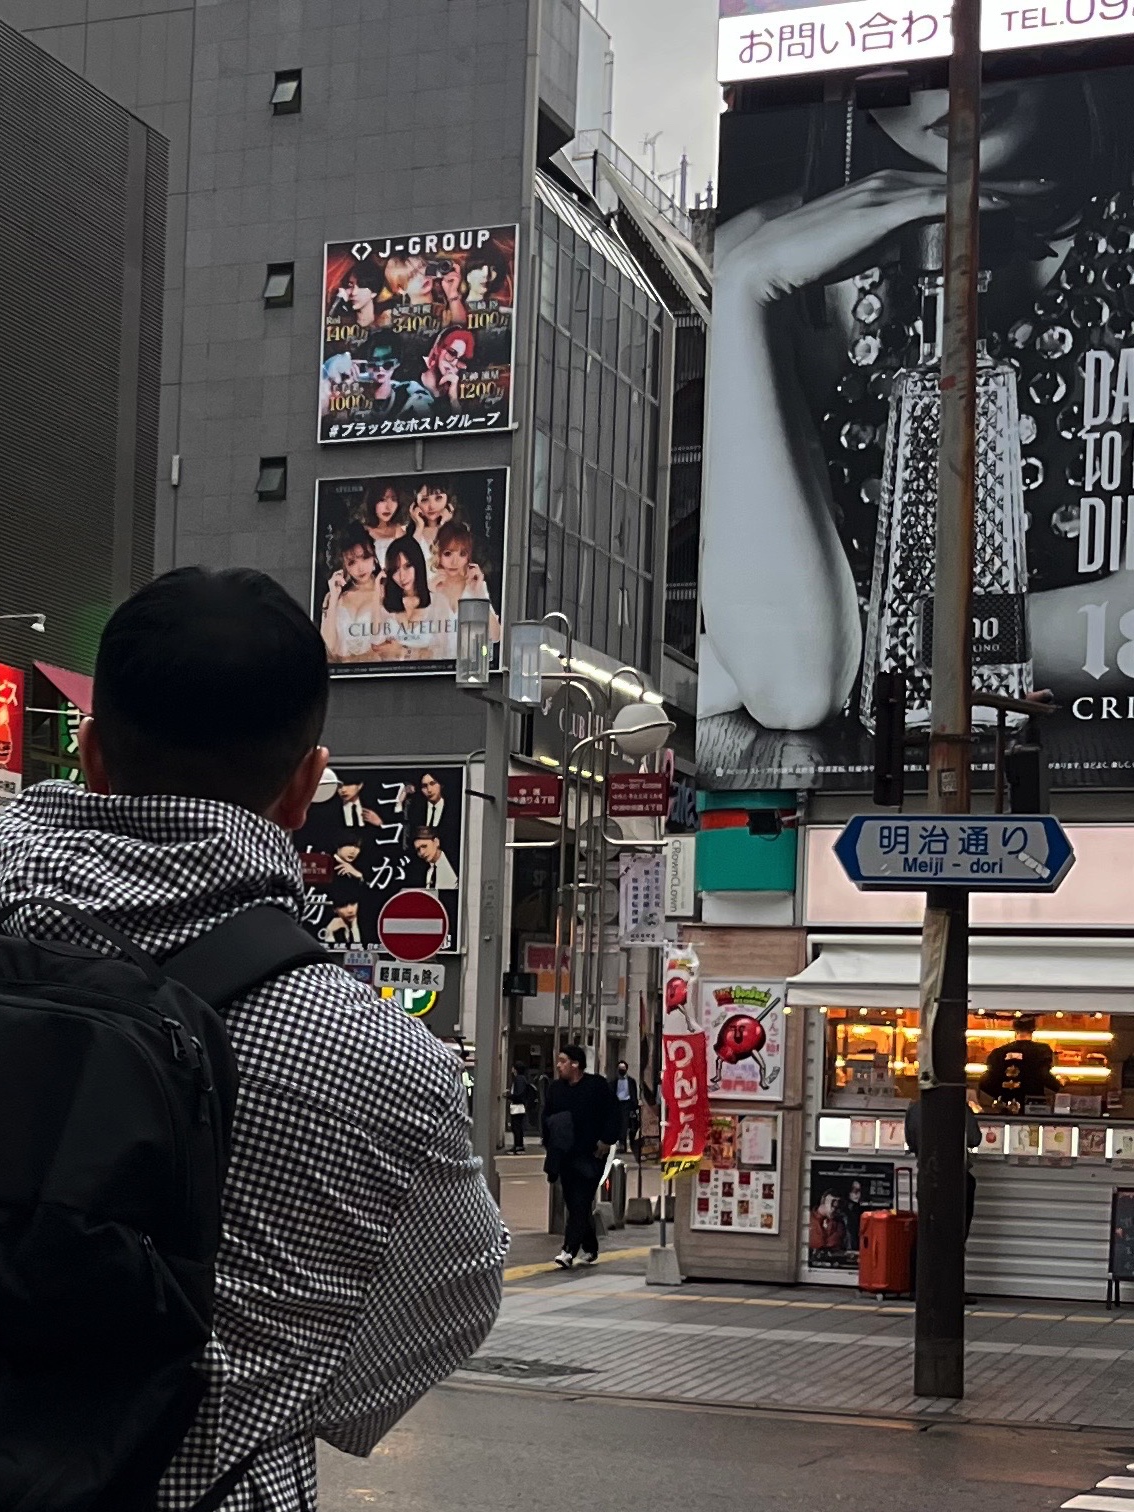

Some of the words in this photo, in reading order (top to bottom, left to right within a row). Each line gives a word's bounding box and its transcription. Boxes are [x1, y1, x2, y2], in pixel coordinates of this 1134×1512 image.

[1001, 0, 1134, 32] TEL.09
[739, 9, 956, 64] お問い合わ
[378, 229, 491, 258] J-GROUP
[328, 411, 501, 438] #ブラックなホストグループ
[1080, 430, 1123, 492] TO
[348, 621, 391, 638] CLUB
[878, 825, 1028, 856] 明治通り
[902, 857, 943, 876] Meiji
[969, 858, 1003, 874] dori
[379, 966, 440, 986] 軽車両を除く
